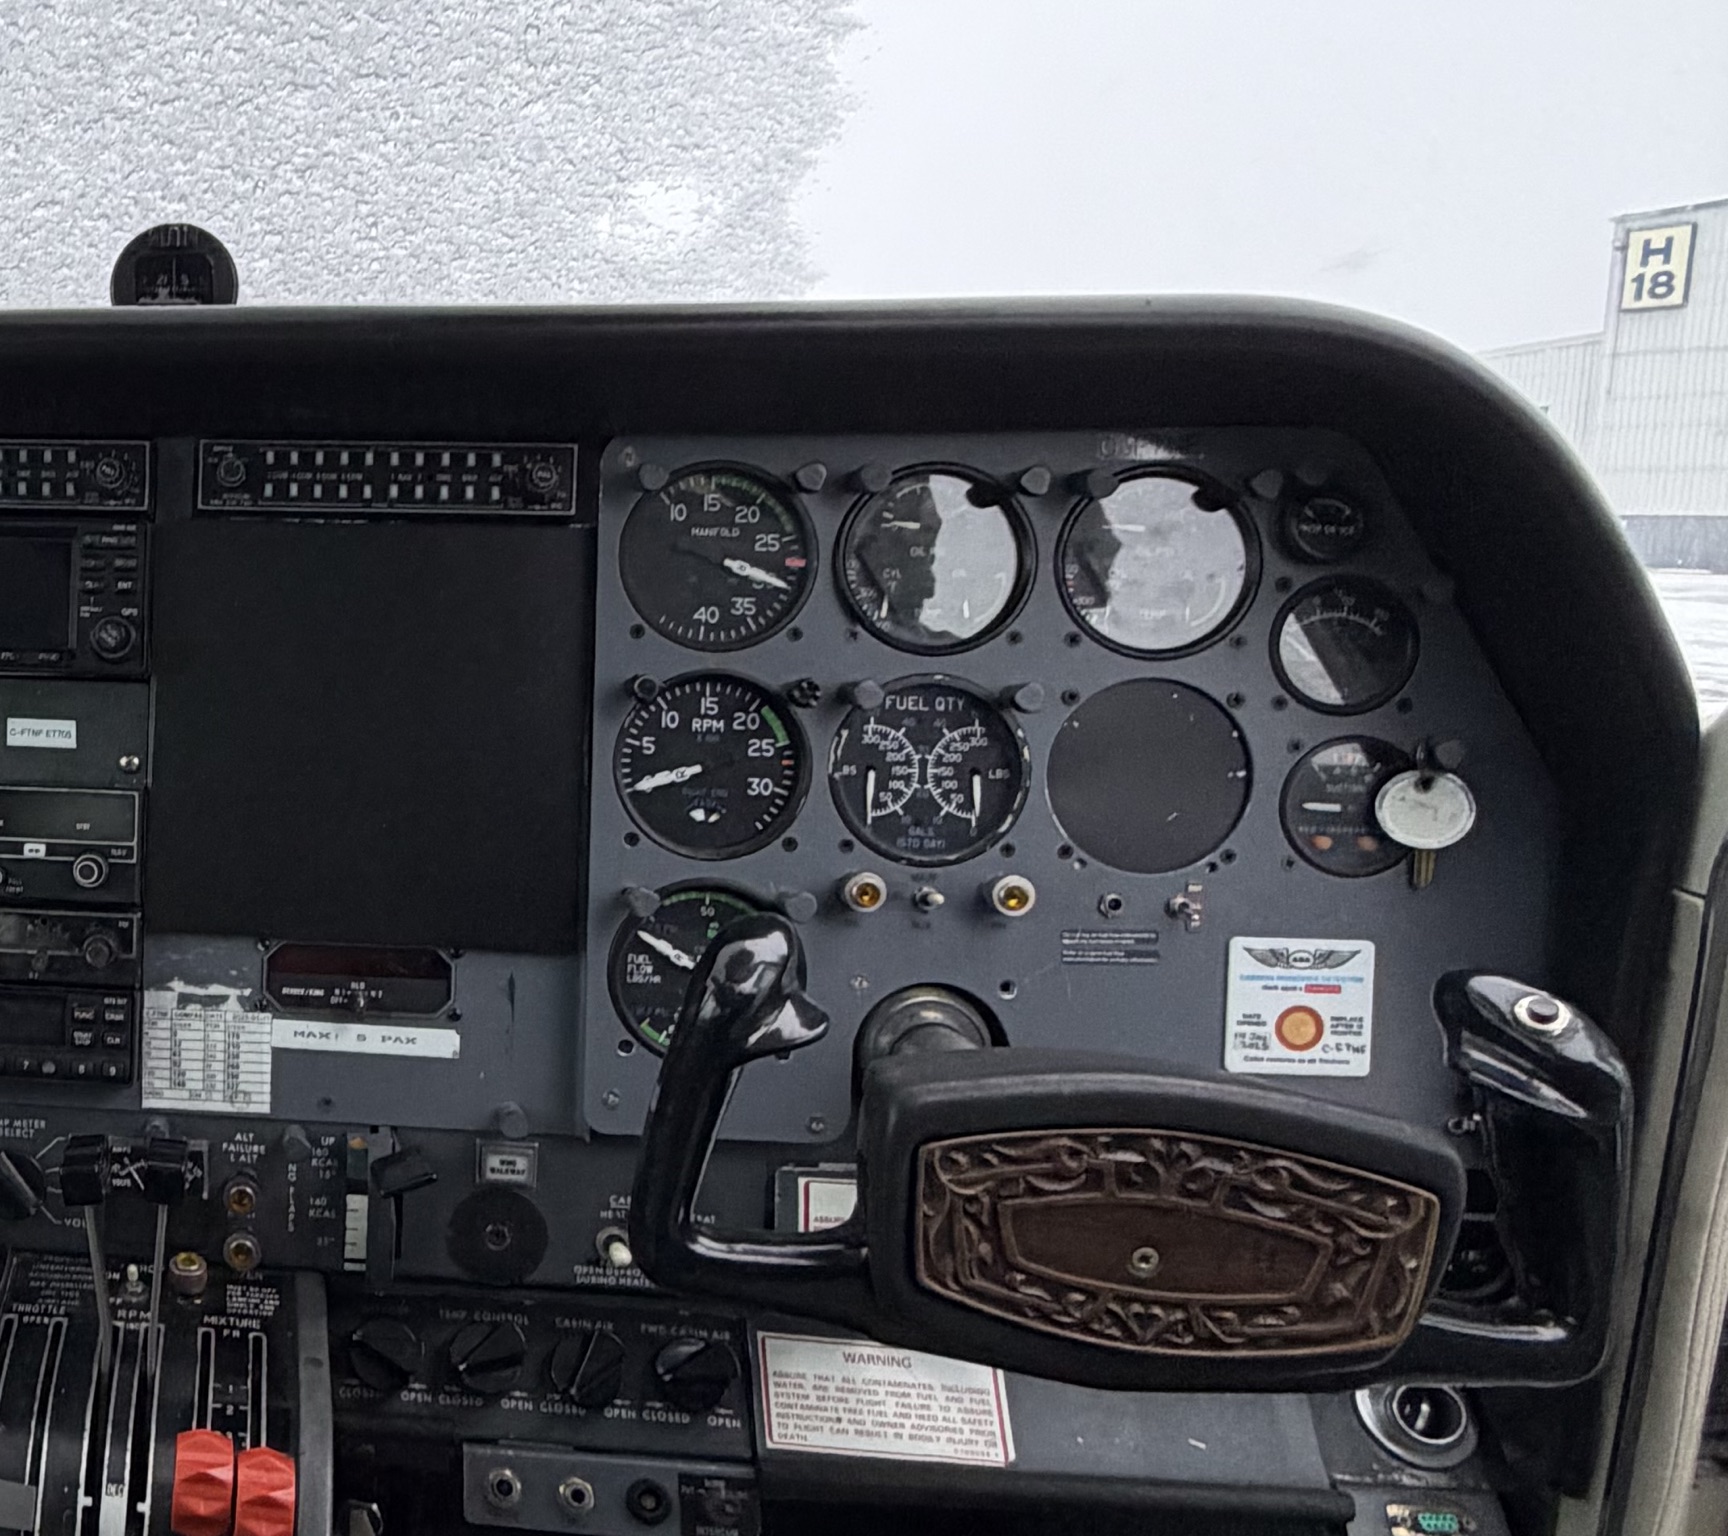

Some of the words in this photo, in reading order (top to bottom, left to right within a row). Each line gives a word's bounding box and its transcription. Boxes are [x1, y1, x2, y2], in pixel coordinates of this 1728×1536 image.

[1640, 236, 1674, 268] H
[1631, 270, 1675, 302] 18
[703, 494, 721, 512] 15
[670, 503, 687, 522] 10
[735, 505, 760, 523] 20
[754, 533, 780, 552] 25
[730, 597, 757, 615] 35
[693, 606, 720, 624] 40
[700, 697, 719, 715] 15
[885, 695, 929, 711] FUEL
[935, 696, 965, 712] QTY
[661, 710, 679, 729] 10
[691, 718, 725, 733] RPM
[732, 712, 760, 730] 20
[642, 736, 656, 754] 5
[747, 738, 775, 757] 25
[942, 753, 962, 763] 200
[746, 777, 773, 796] 30
[889, 780, 905, 790] 100
[941, 780, 958, 790] 100
[879, 792, 892, 802] 50
[950, 793, 964, 803] 50
[628, 954, 651, 963] FUEL
[627, 964, 653, 974] FLOW
[381, 1035, 417, 1045] PAX
[14, 1118, 46, 1129] METER
[234, 1132, 254, 1142] ALT
[320, 1136, 336, 1145] UP
[222, 1142, 266, 1155] FAILURE
[312, 1148, 329, 1156] 160
[239, 1155, 258, 1164] ALT
[11, 1303, 66, 1316] THROTTLE
[117, 1308, 152, 1321] RPM
[203, 1315, 260, 1329] MIXTURE
[842, 1351, 912, 1369] WARNING
[401, 1390, 432, 1403] OPEN
[916, 1390, 938, 1402] FUEL
[969, 1396, 992, 1406] FUEL
[500, 1398, 533, 1412] OPEN
[603, 1406, 636, 1420] OPEN
[642, 1409, 690, 1424] CLOSED
[707, 1415, 741, 1429] OPEN
